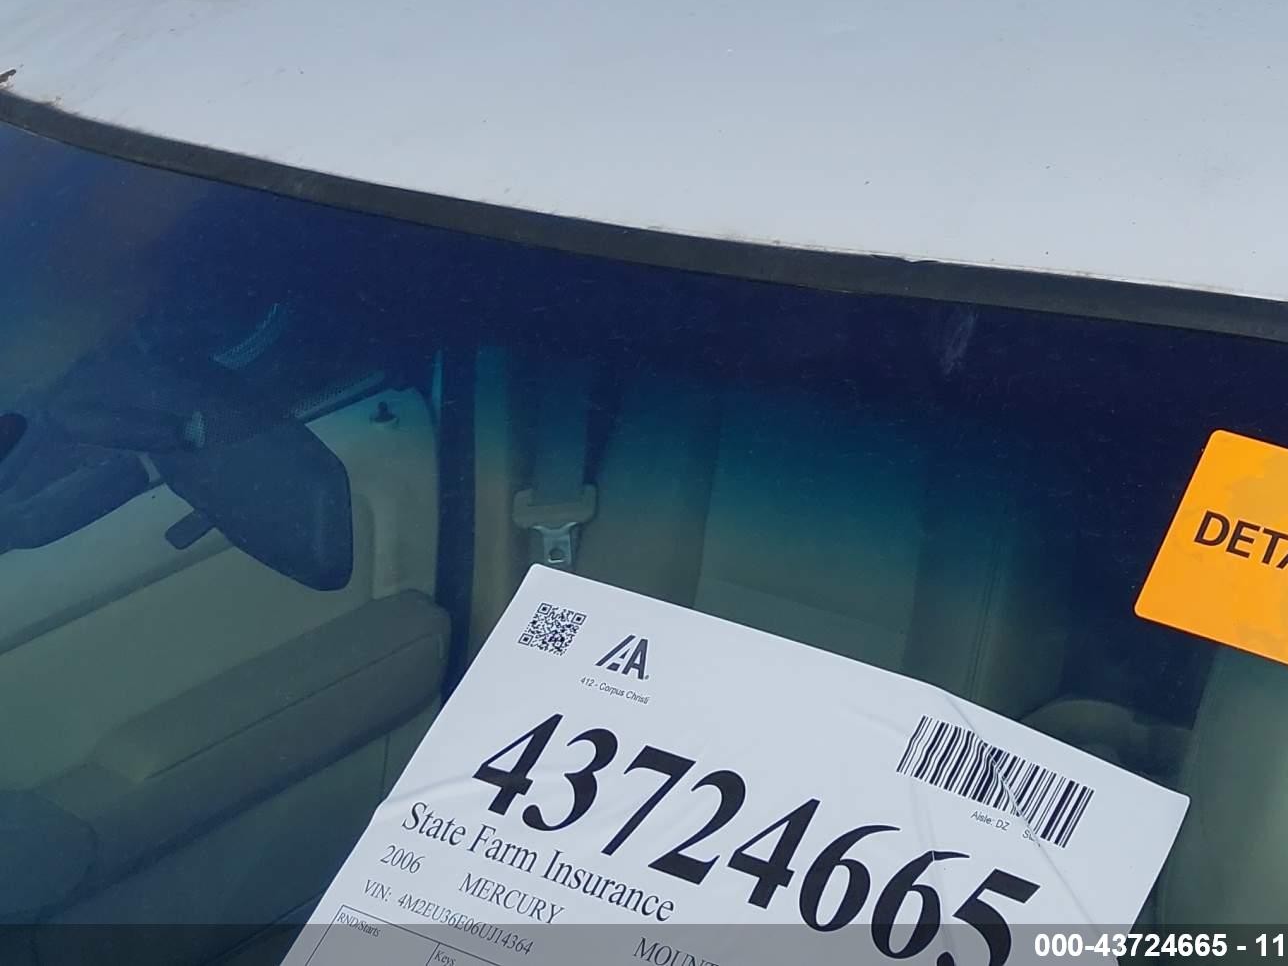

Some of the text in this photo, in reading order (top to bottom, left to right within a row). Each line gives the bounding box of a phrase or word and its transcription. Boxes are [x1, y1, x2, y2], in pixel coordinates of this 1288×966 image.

[580, 677, 595, 687] 412
[600, 682, 625, 696] Corpus
[626, 691, 650, 705] Christi
[472, 713, 1041, 966] 43724665
[995, 819, 1010, 831] DZ
[380, 845, 425, 874] 2006
[458, 872, 565, 924] MERCURY
[401, 801, 675, 922] State Farm Insurance
[364, 879, 392, 903] VIN:
